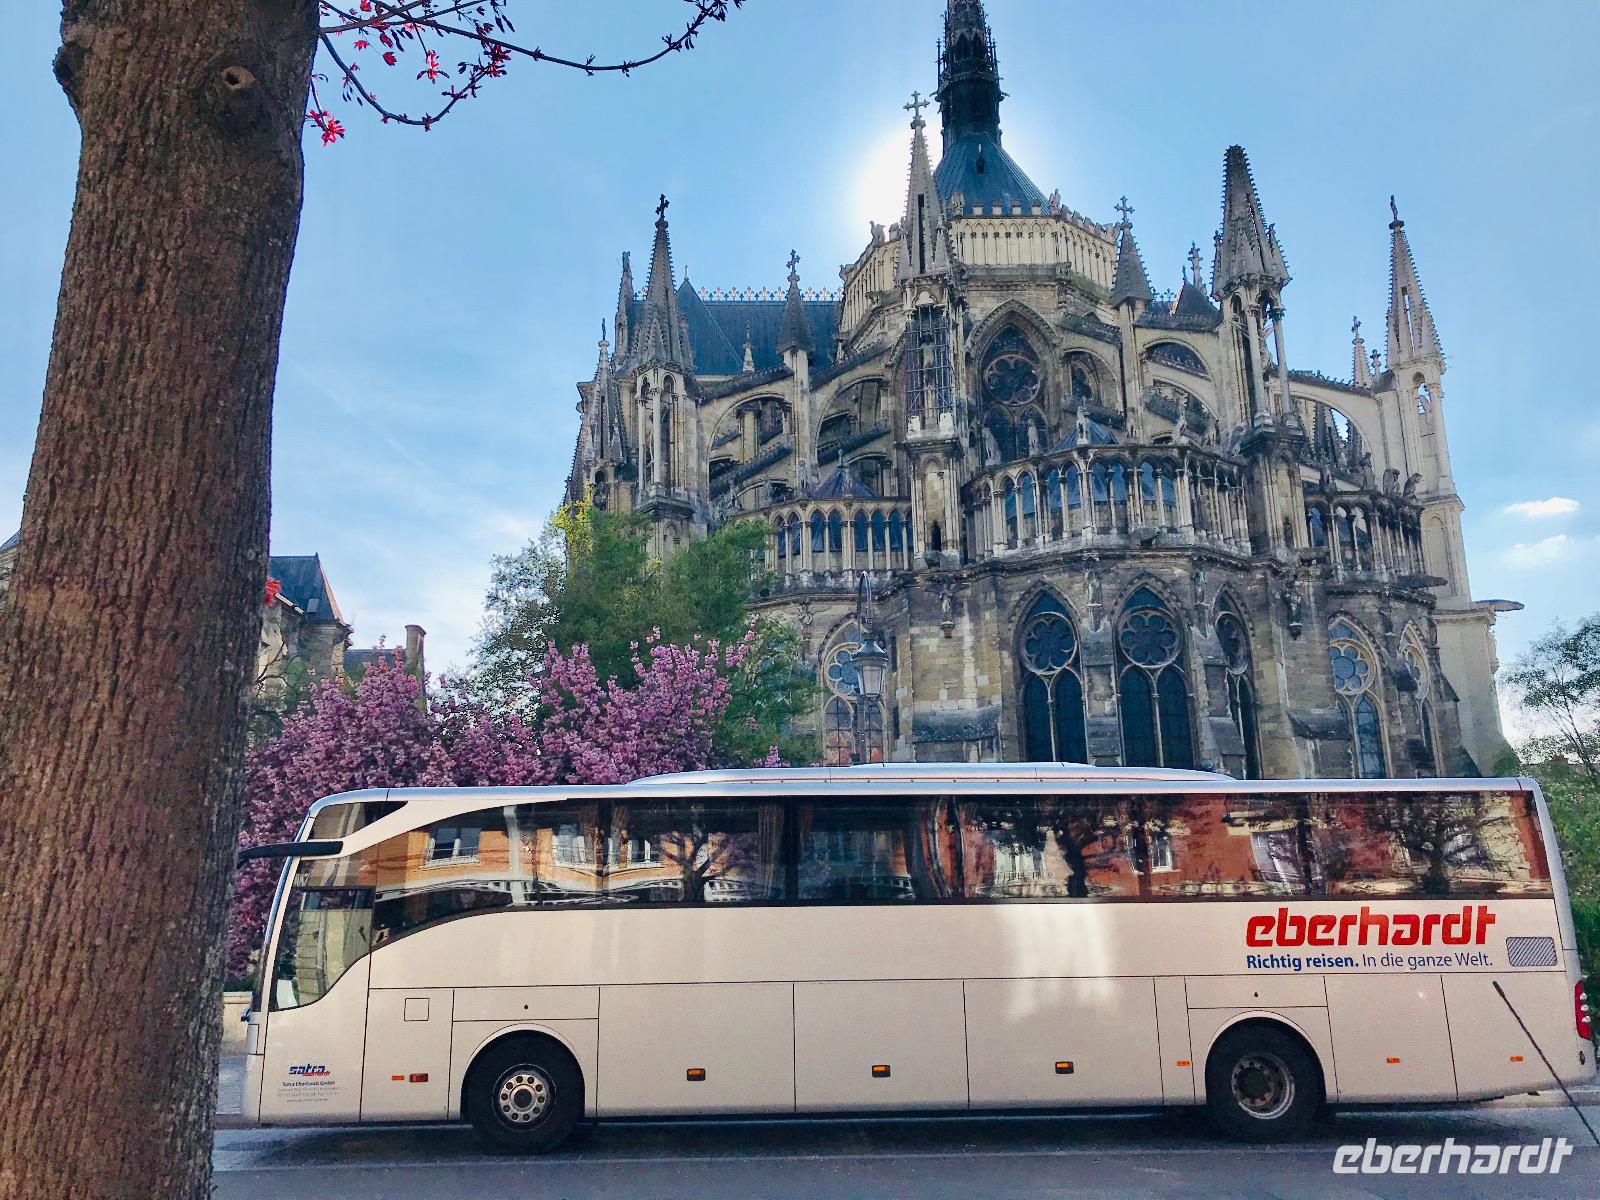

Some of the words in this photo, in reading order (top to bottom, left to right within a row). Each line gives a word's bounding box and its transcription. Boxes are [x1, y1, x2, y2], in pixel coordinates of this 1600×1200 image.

[1246, 905, 1496, 948] eberhardt
[1246, 953, 1303, 972] Richtig
[1306, 954, 1359, 968] reisen.
[1362, 953, 1378, 967] In
[1381, 952, 1404, 967] die
[1407, 955, 1452, 971] ganze
[1454, 951, 1493, 967] Welt.
[289, 1064, 326, 1075] satra
